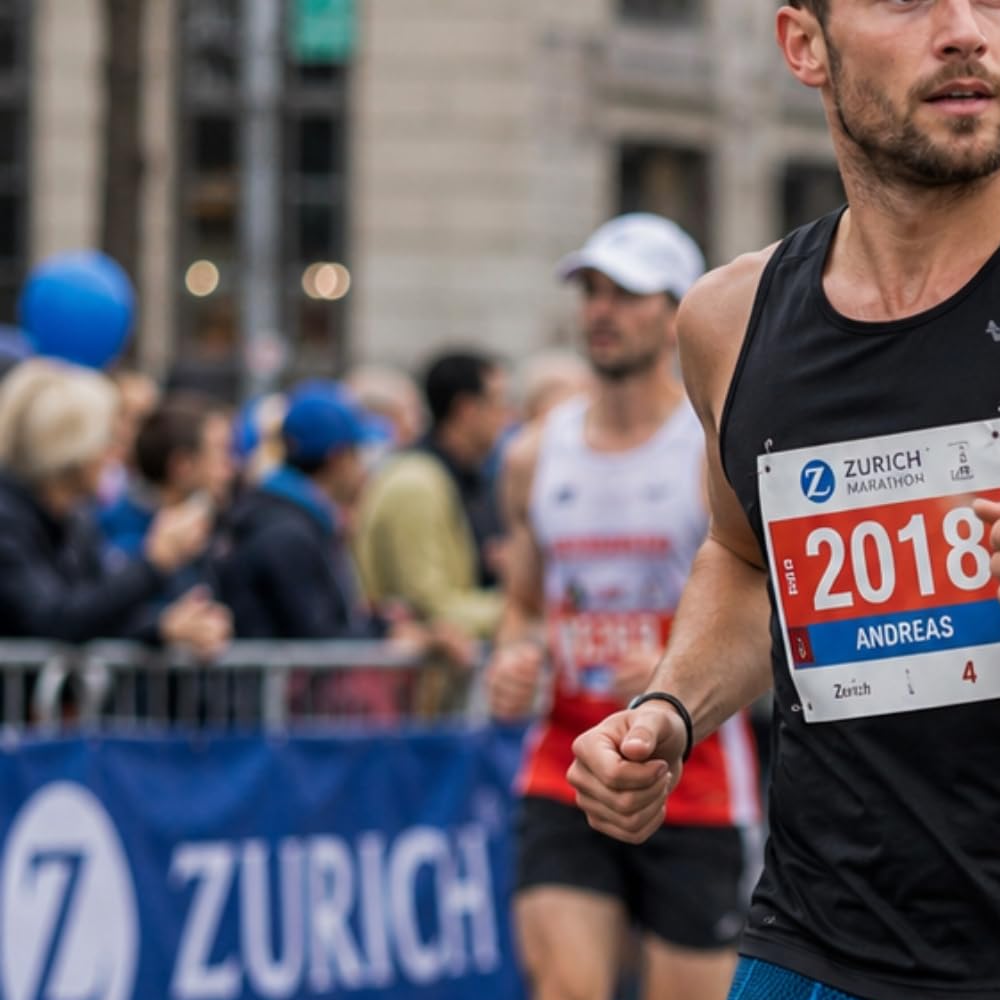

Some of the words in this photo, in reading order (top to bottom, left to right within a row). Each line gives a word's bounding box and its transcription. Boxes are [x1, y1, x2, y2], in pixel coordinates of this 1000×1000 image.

[843, 449, 923, 479] ZURICH
[847, 472, 926, 496] MARATHON
[805, 505, 993, 611] 2018
[856, 614, 955, 652] ANDREAS
[962, 659, 977, 684] 4
